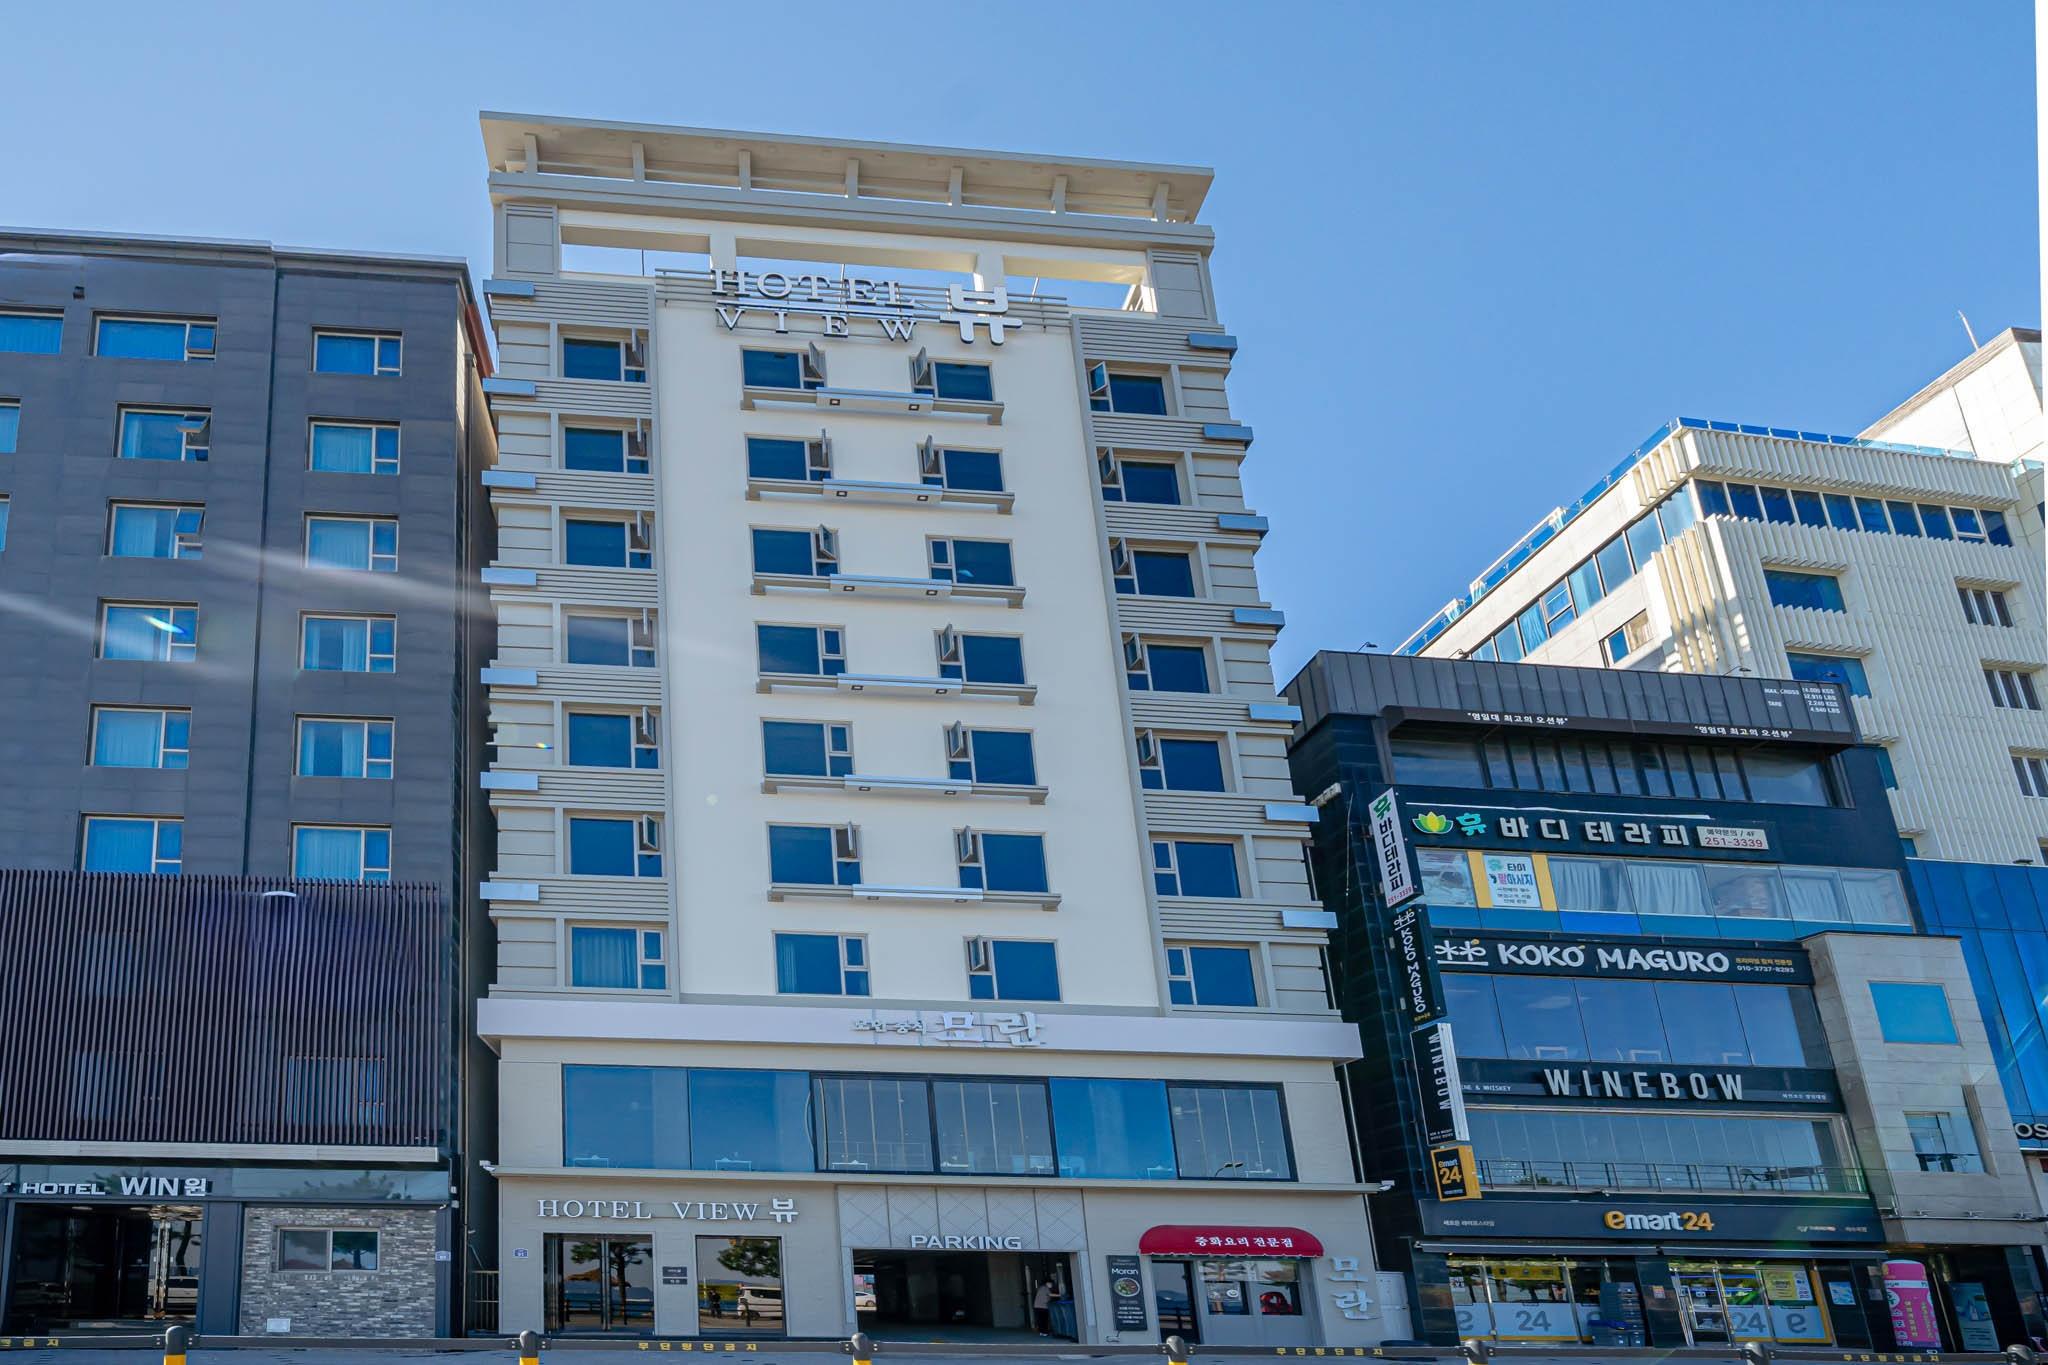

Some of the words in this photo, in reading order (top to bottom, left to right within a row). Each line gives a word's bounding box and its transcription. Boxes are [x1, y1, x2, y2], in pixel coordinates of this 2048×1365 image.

[711, 268, 915, 309] HOTEL
[715, 306, 918, 342] VIEW
[940, 283, 1023, 346] 뷰
[1373, 794, 1392, 820] 휴
[1455, 812, 1487, 837] 휴
[1705, 837, 1763, 848] 251-3339
[1401, 927, 1417, 961] KOKO
[1497, 943, 1585, 967] KOKO
[1597, 947, 1730, 973] MAGURO
[1407, 961, 1426, 1013] MAGURO
[1428, 1032, 1452, 1110] WINEBOW
[1543, 1068, 1743, 1101] WINEBOW
[1438, 1159, 1458, 1168] emart
[1440, 1166, 1461, 1185] 24
[20, 1183, 105, 1195] HOTEL
[537, 1200, 651, 1219] HOTEL
[672, 1202, 759, 1220] VIEW
[769, 1198, 799, 1223] 뷰
[1604, 1210, 1714, 1231] emart24
[911, 1235, 1022, 1249] PARKING
[1195, 1236, 1249, 1247] 중화요리
[1253, 1236, 1293, 1248] 전문점
[1515, 1310, 1551, 1332] 24
[1733, 1311, 1766, 1333] 24
[1785, 1313, 1807, 1334] e
